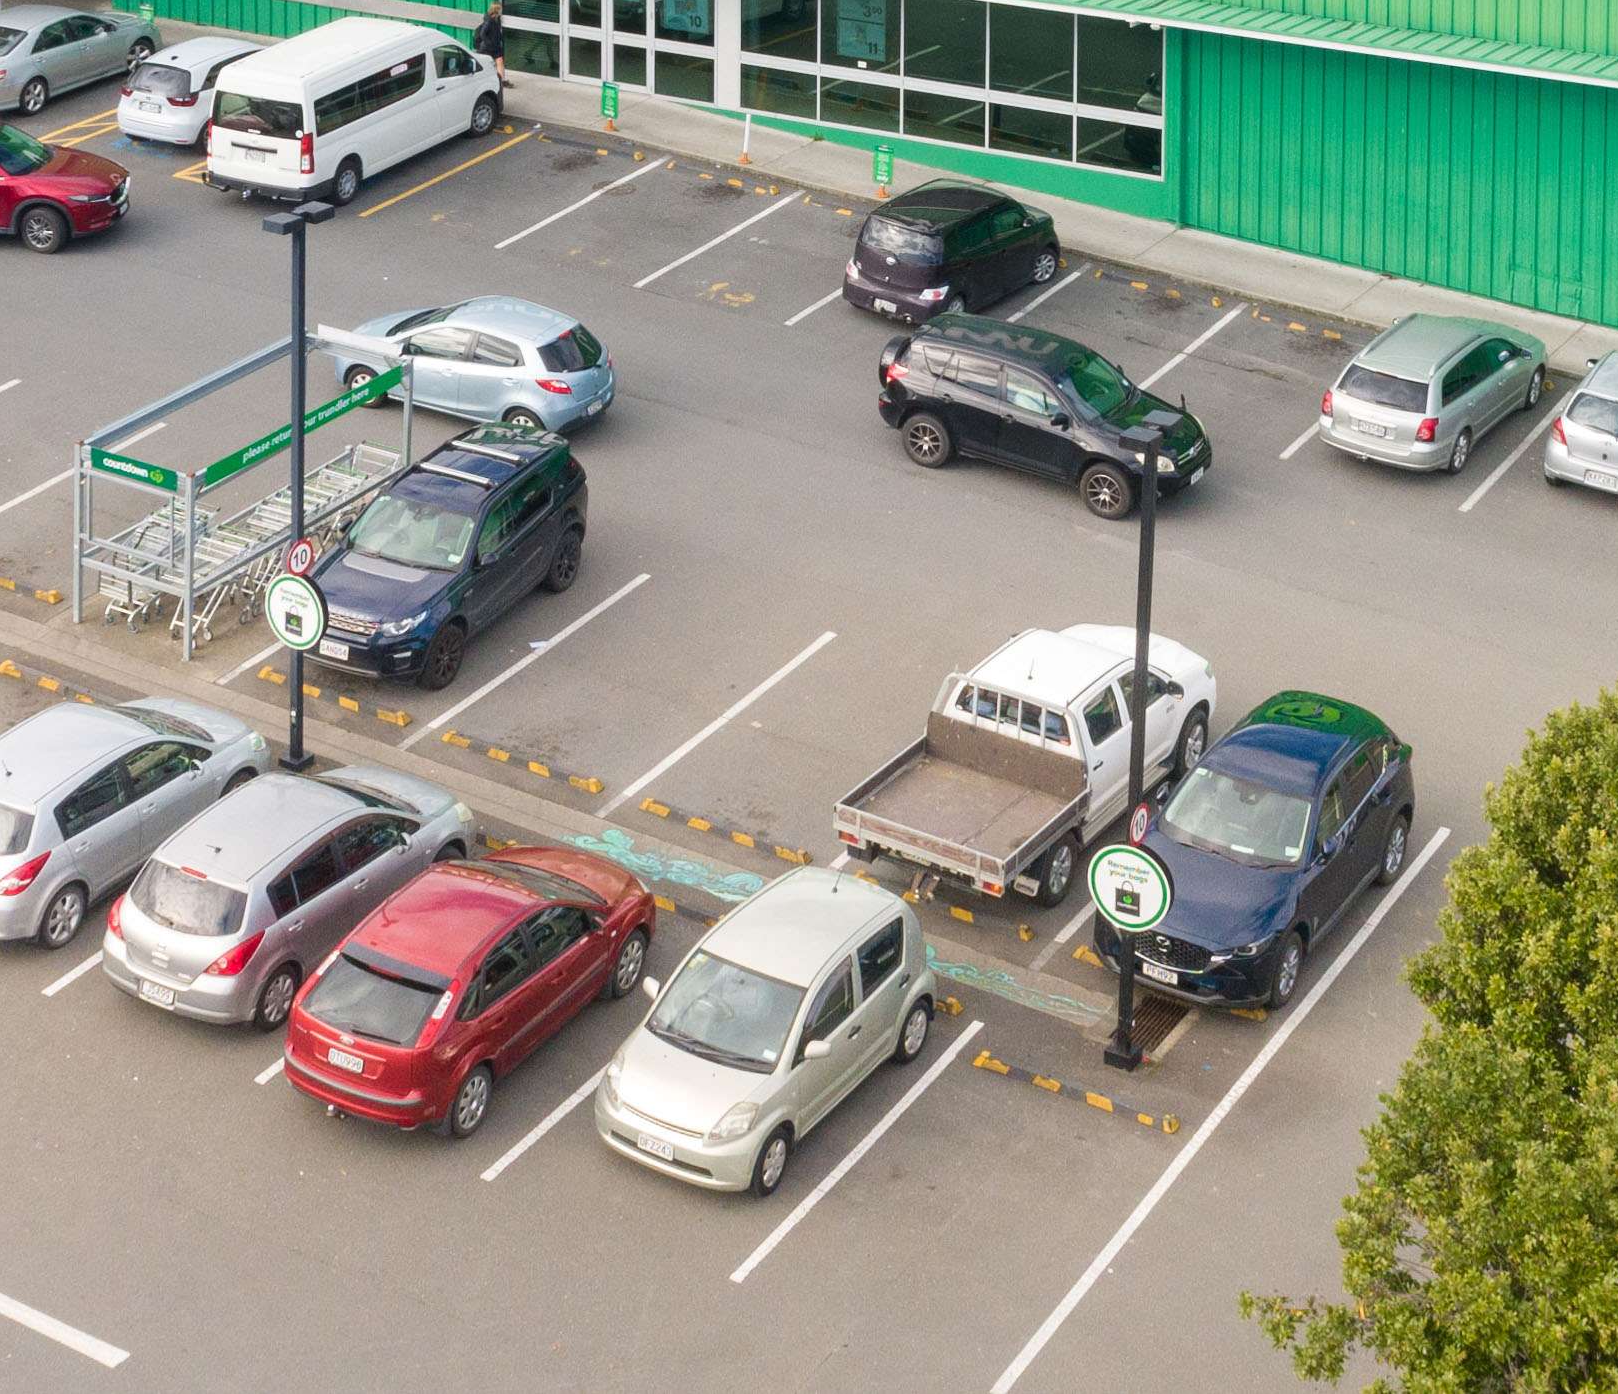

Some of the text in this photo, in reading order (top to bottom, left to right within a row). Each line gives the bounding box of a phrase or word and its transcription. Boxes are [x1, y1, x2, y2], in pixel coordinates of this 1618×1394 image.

[242, 441, 271, 465] please
[271, 429, 293, 450] retur
[318, 398, 350, 423] trundler
[351, 388, 370, 406] here
[103, 457, 148, 479] countdown
[293, 549, 308, 567] 10
[1135, 813, 1145, 837] 10
[1107, 859, 1151, 875] Remember
[1109, 869, 1149, 884] your bags
